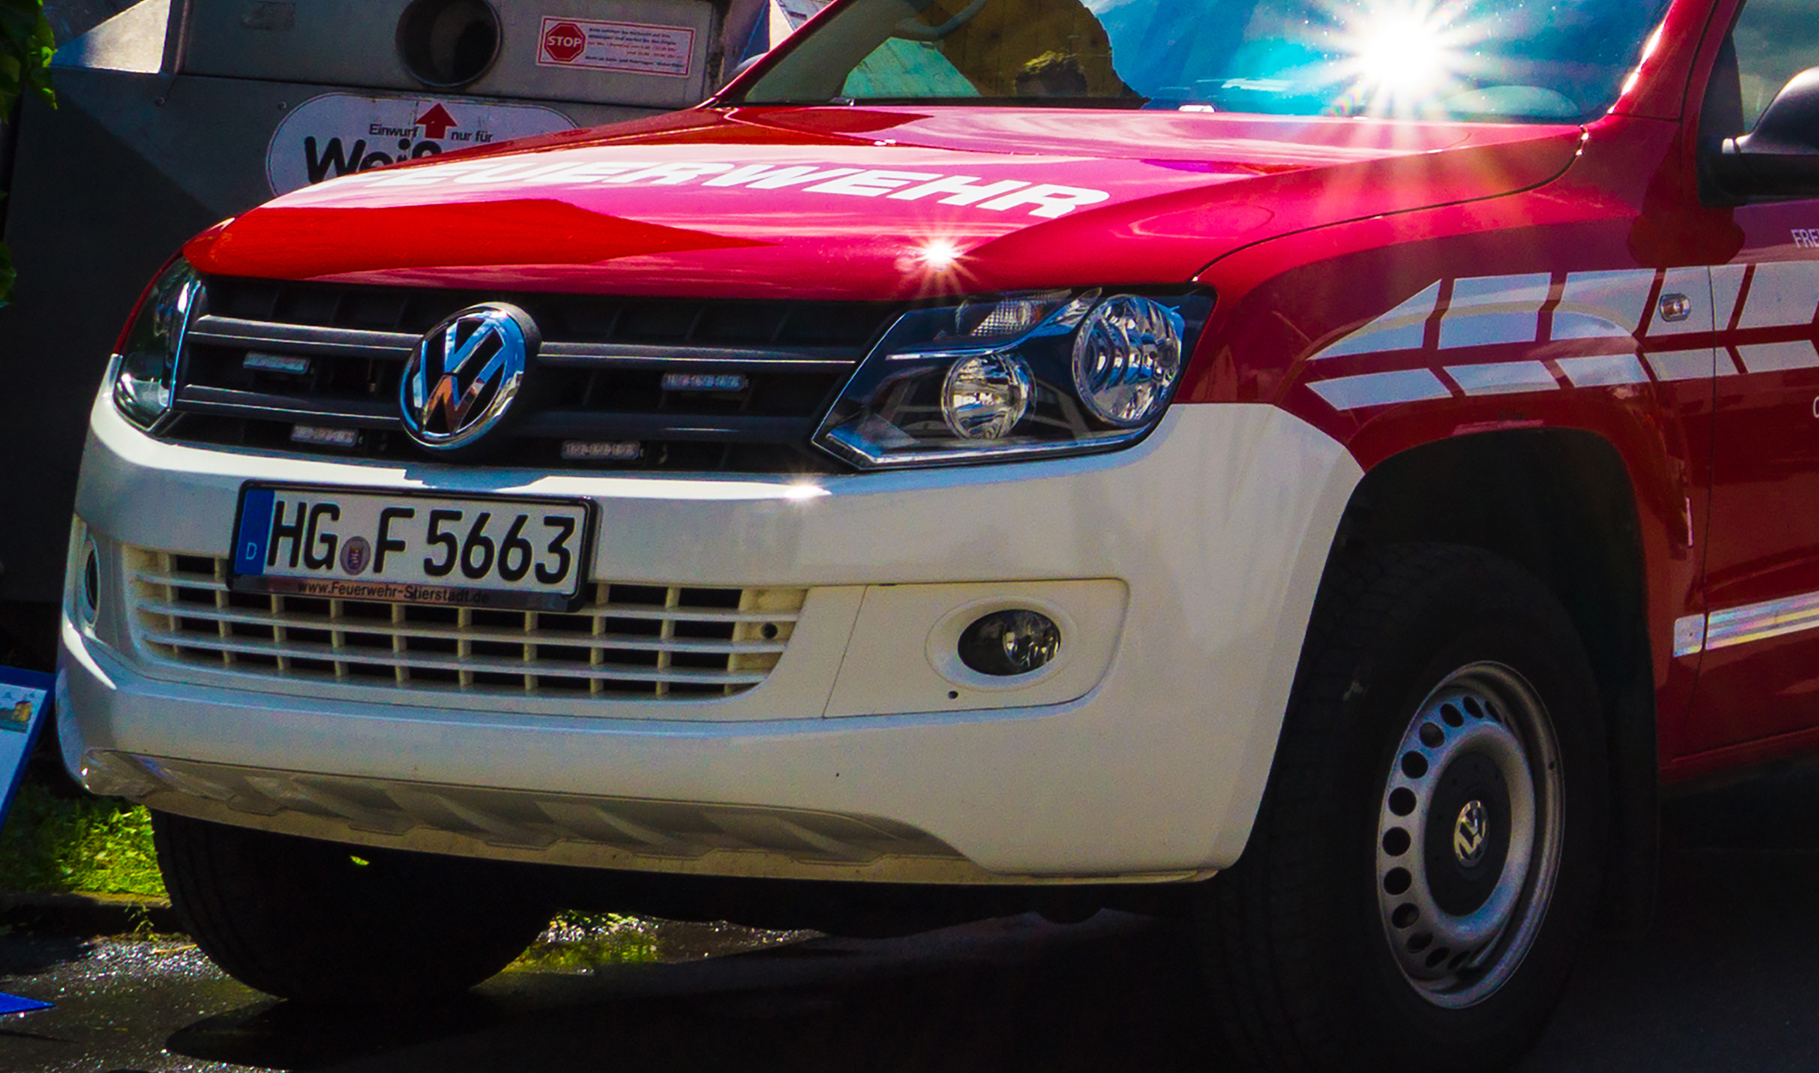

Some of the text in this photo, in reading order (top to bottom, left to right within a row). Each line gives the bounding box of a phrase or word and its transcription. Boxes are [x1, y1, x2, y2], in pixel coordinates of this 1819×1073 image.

[548, 34, 583, 48] STOP
[368, 122, 494, 143] Einwurf nur für
[266, 500, 341, 570] HG
[373, 506, 416, 574] F
[423, 508, 577, 585] 5663
[297, 579, 490, 605] www.Feuerwehr-Stierstadt.de
